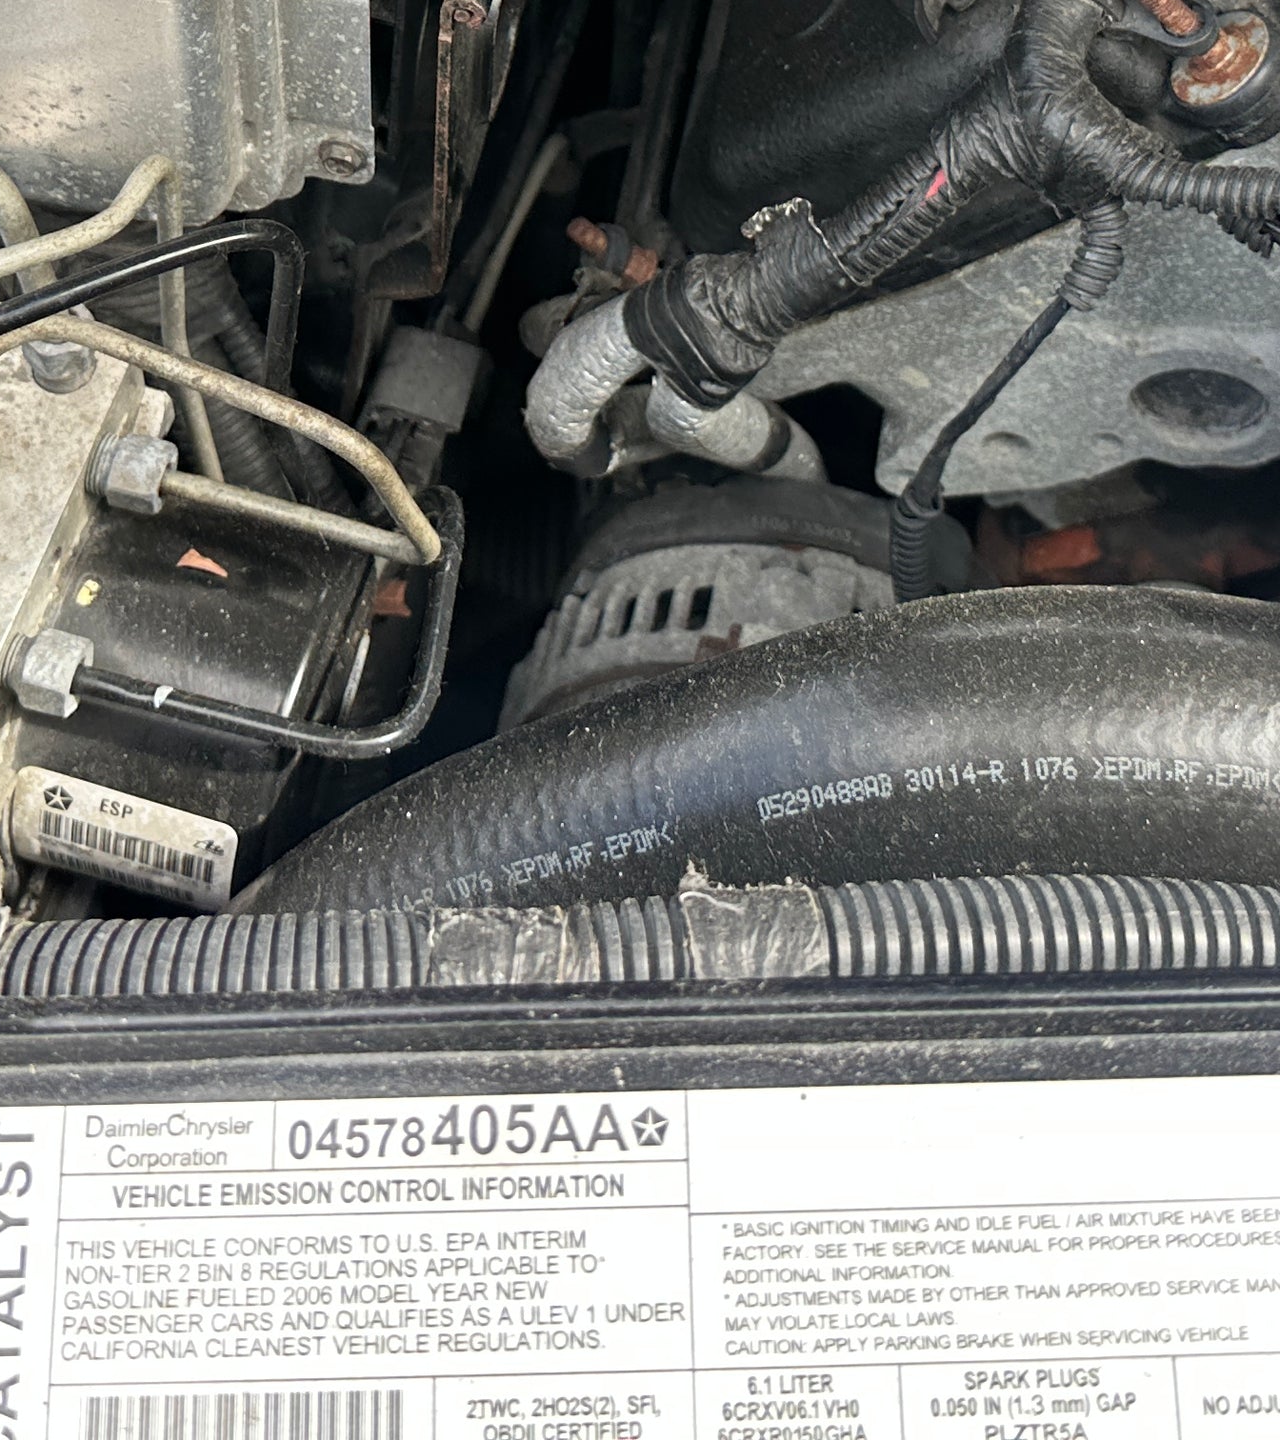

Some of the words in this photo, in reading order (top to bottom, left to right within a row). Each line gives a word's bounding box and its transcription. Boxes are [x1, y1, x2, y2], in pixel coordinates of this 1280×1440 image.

[1020, 756, 1079, 782] 1076
[99, 797, 134, 819] ESP
[85, 1112, 254, 1140] DaimlerChrysler
[288, 1103, 629, 1160] 04578405AA
[107, 1144, 228, 1172] Corporation
[113, 1183, 212, 1210] VEHICLE
[220, 1180, 332, 1208] EMISSION
[341, 1178, 454, 1205] CONTROL
[462, 1174, 624, 1202] INFORMATION
[734, 1221, 784, 1238] BASIC
[791, 1219, 864, 1237] IGNITION
[870, 1217, 929, 1235] TIMING
[935, 1216, 969, 1233] AND
[976, 1215, 1012, 1232] IDLE
[1018, 1213, 1061, 1231] FUEL
[1076, 1212, 1103, 1229] AIR
[1109, 1210, 1184, 1228] MIXTURE
[1191, 1208, 1234, 1226] HAVE
[67, 1240, 115, 1261] THIS
[123, 1238, 216, 1260] VEHICLE
[224, 1235, 352, 1257] CONFORMS
[360, 1234, 389, 1254] TO
[397, 1233, 437, 1254] U.S.
[447, 1232, 489, 1253] EPA
[498, 1230, 586, 1251] INTERIM
[815, 1242, 847, 1259] SEE
[853, 1241, 886, 1258] THE
[893, 1238, 966, 1257] SERVICE
[972, 1236, 1042, 1255] MANUAL
[1048, 1235, 1083, 1253] FOR
[1089, 1233, 1161, 1252] PROPER
[66, 1264, 171, 1285] NON-TIER
[198, 1263, 232, 1282] BIN
[260, 1259, 417, 1281] REGULATIONS
[424, 1257, 560, 1278] APPLICABLE
[567, 1256, 597, 1276] TO
[723, 1266, 825, 1284] ADDITIONAL
[64, 1288, 178, 1310] GASOLINE
[187, 1286, 275, 1308] FUELED
[283, 1284, 332, 1306] 2006
[341, 1283, 420, 1305] MODEL
[428, 1281, 488, 1303] YEAR
[496, 1280, 547, 1302] NEW
[735, 1289, 862, 1309] ADJUSTMENTS
[868, 1287, 916, 1305] MADE
[922, 1286, 944, 1304] BY
[950, 1284, 1009, 1303] OTHER
[1015, 1283, 1060, 1301] THAN
[1066, 1280, 1160, 1300] APPROVED
[1167, 1278, 1240, 1297] SERVICE
[63, 1312, 203, 1336] PASSENGER
[212, 1311, 273, 1333] CARS
[281, 1310, 329, 1331] AND
[336, 1307, 453, 1330] QUALIFIES
[461, 1306, 491, 1328] AS
[521, 1304, 578, 1327] ULEV
[606, 1302, 685, 1325] UNDER
[725, 1316, 761, 1333] MAY
[767, 1314, 839, 1332] VIOLATE
[845, 1312, 901, 1330] LOCAL
[62, 1338, 197, 1361] CALIFORNIA
[206, 1336, 326, 1359] CLEANEST
[333, 1334, 429, 1356] VEHICLE
[438, 1330, 605, 1354] REGULATIONS.
[813, 1336, 868, 1353] APPLY
[874, 1333, 951, 1352] PARKING
[957, 1332, 1014, 1349] BRAKE
[1020, 1330, 1072, 1348] WHEN
[1077, 1327, 1171, 1346] SERVICING
[1177, 1325, 1248, 1343] VEHICLE
[748, 1375, 771, 1395] 6.1
[780, 1374, 834, 1395] LITER
[964, 1369, 1030, 1390] SPARK
[1036, 1367, 1100, 1389] PLUGS
[931, 1395, 977, 1418] 0.050
[984, 1394, 1001, 1417] IN
[1008, 1394, 1045, 1416] (1.3
[1052, 1393, 1090, 1415] mm)
[1096, 1392, 1136, 1415] GAP
[1203, 1393, 1230, 1416] NO
[484, 1423, 535, 1440] OBDII
[542, 1422, 642, 1440] CERTIFIED
